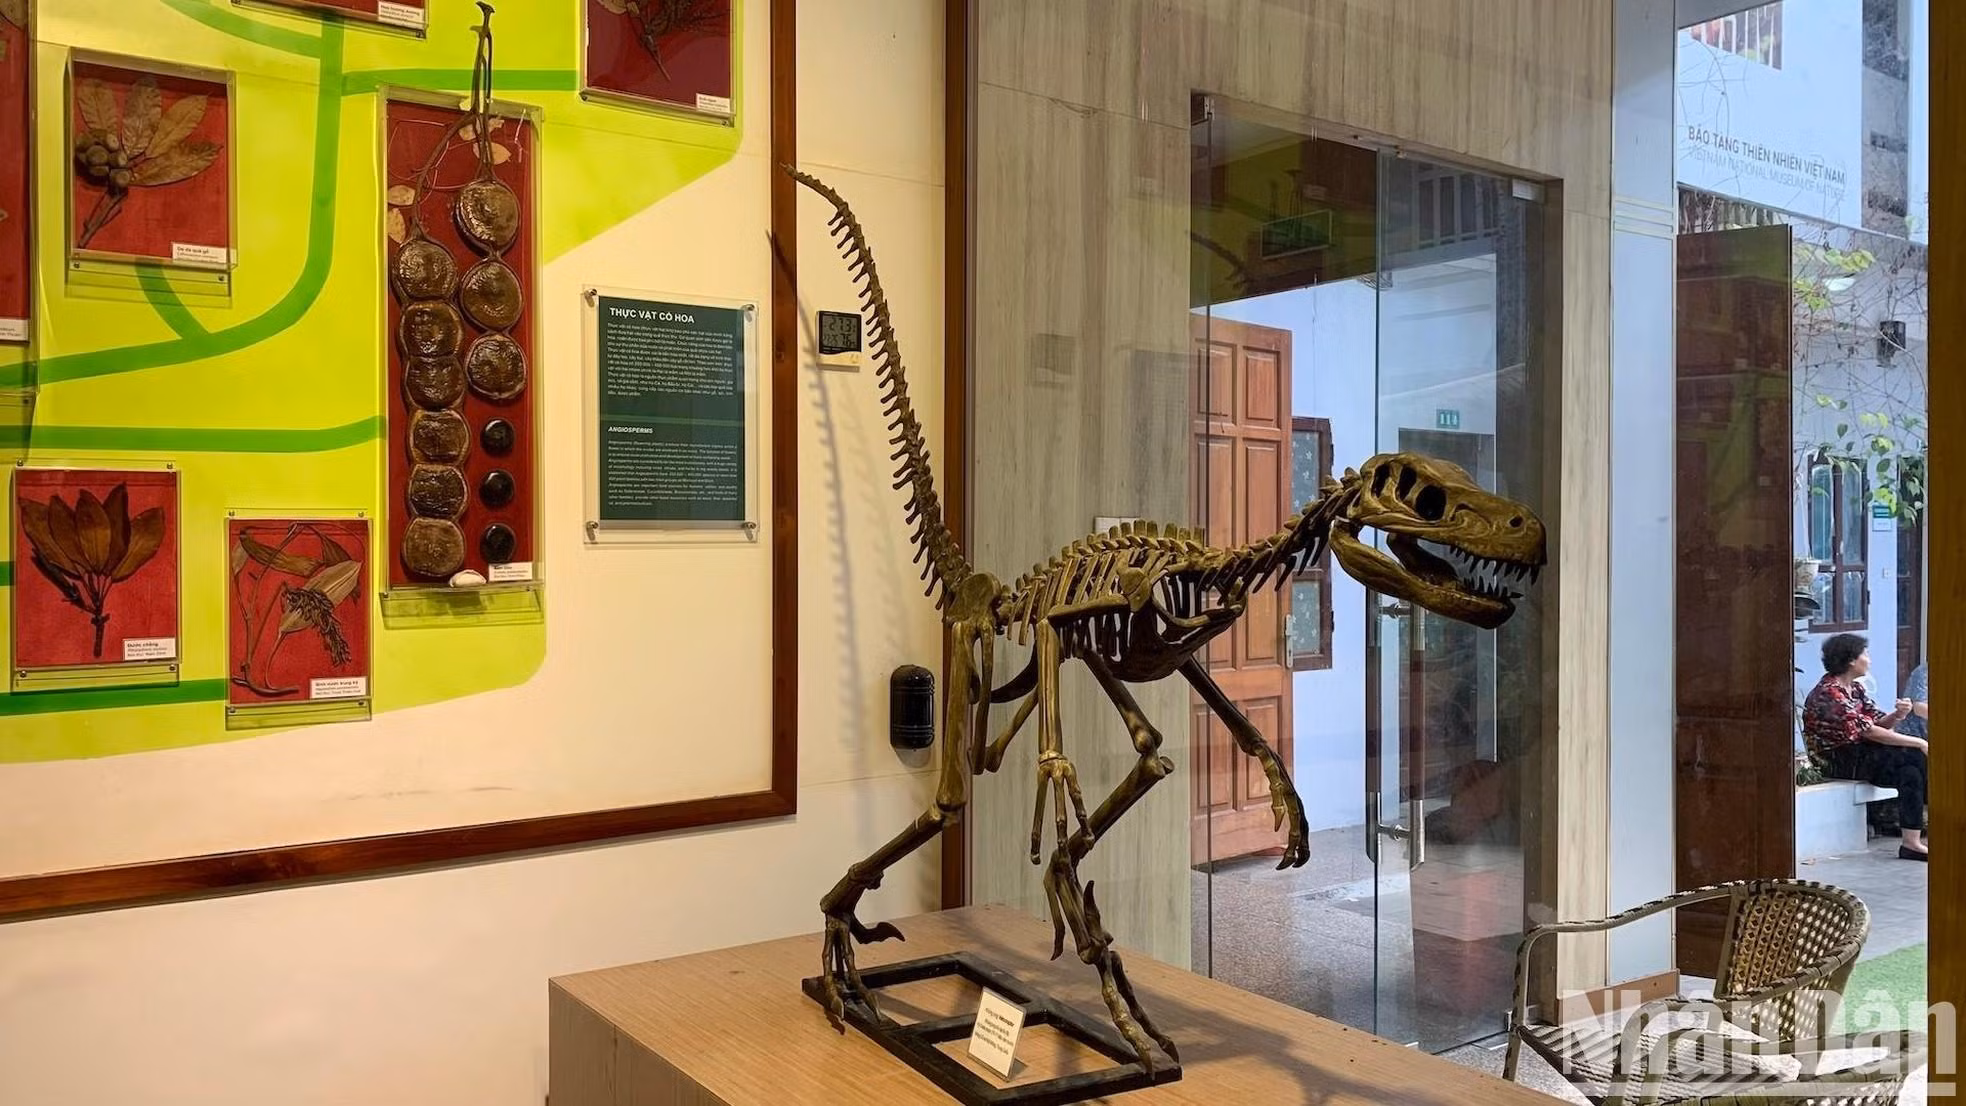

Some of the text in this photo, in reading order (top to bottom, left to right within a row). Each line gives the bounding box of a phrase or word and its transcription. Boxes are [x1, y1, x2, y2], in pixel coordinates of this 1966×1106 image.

[1688, 124, 1845, 185] BẢO TÀNG THIÊN NHIÊN VIỆT NAM
[1728, 157, 1768, 180] NATIONAL
[609, 307, 695, 323] THỰC VẬT CÓ HOA
[608, 426, 654, 434] ANGIOSPERMS
